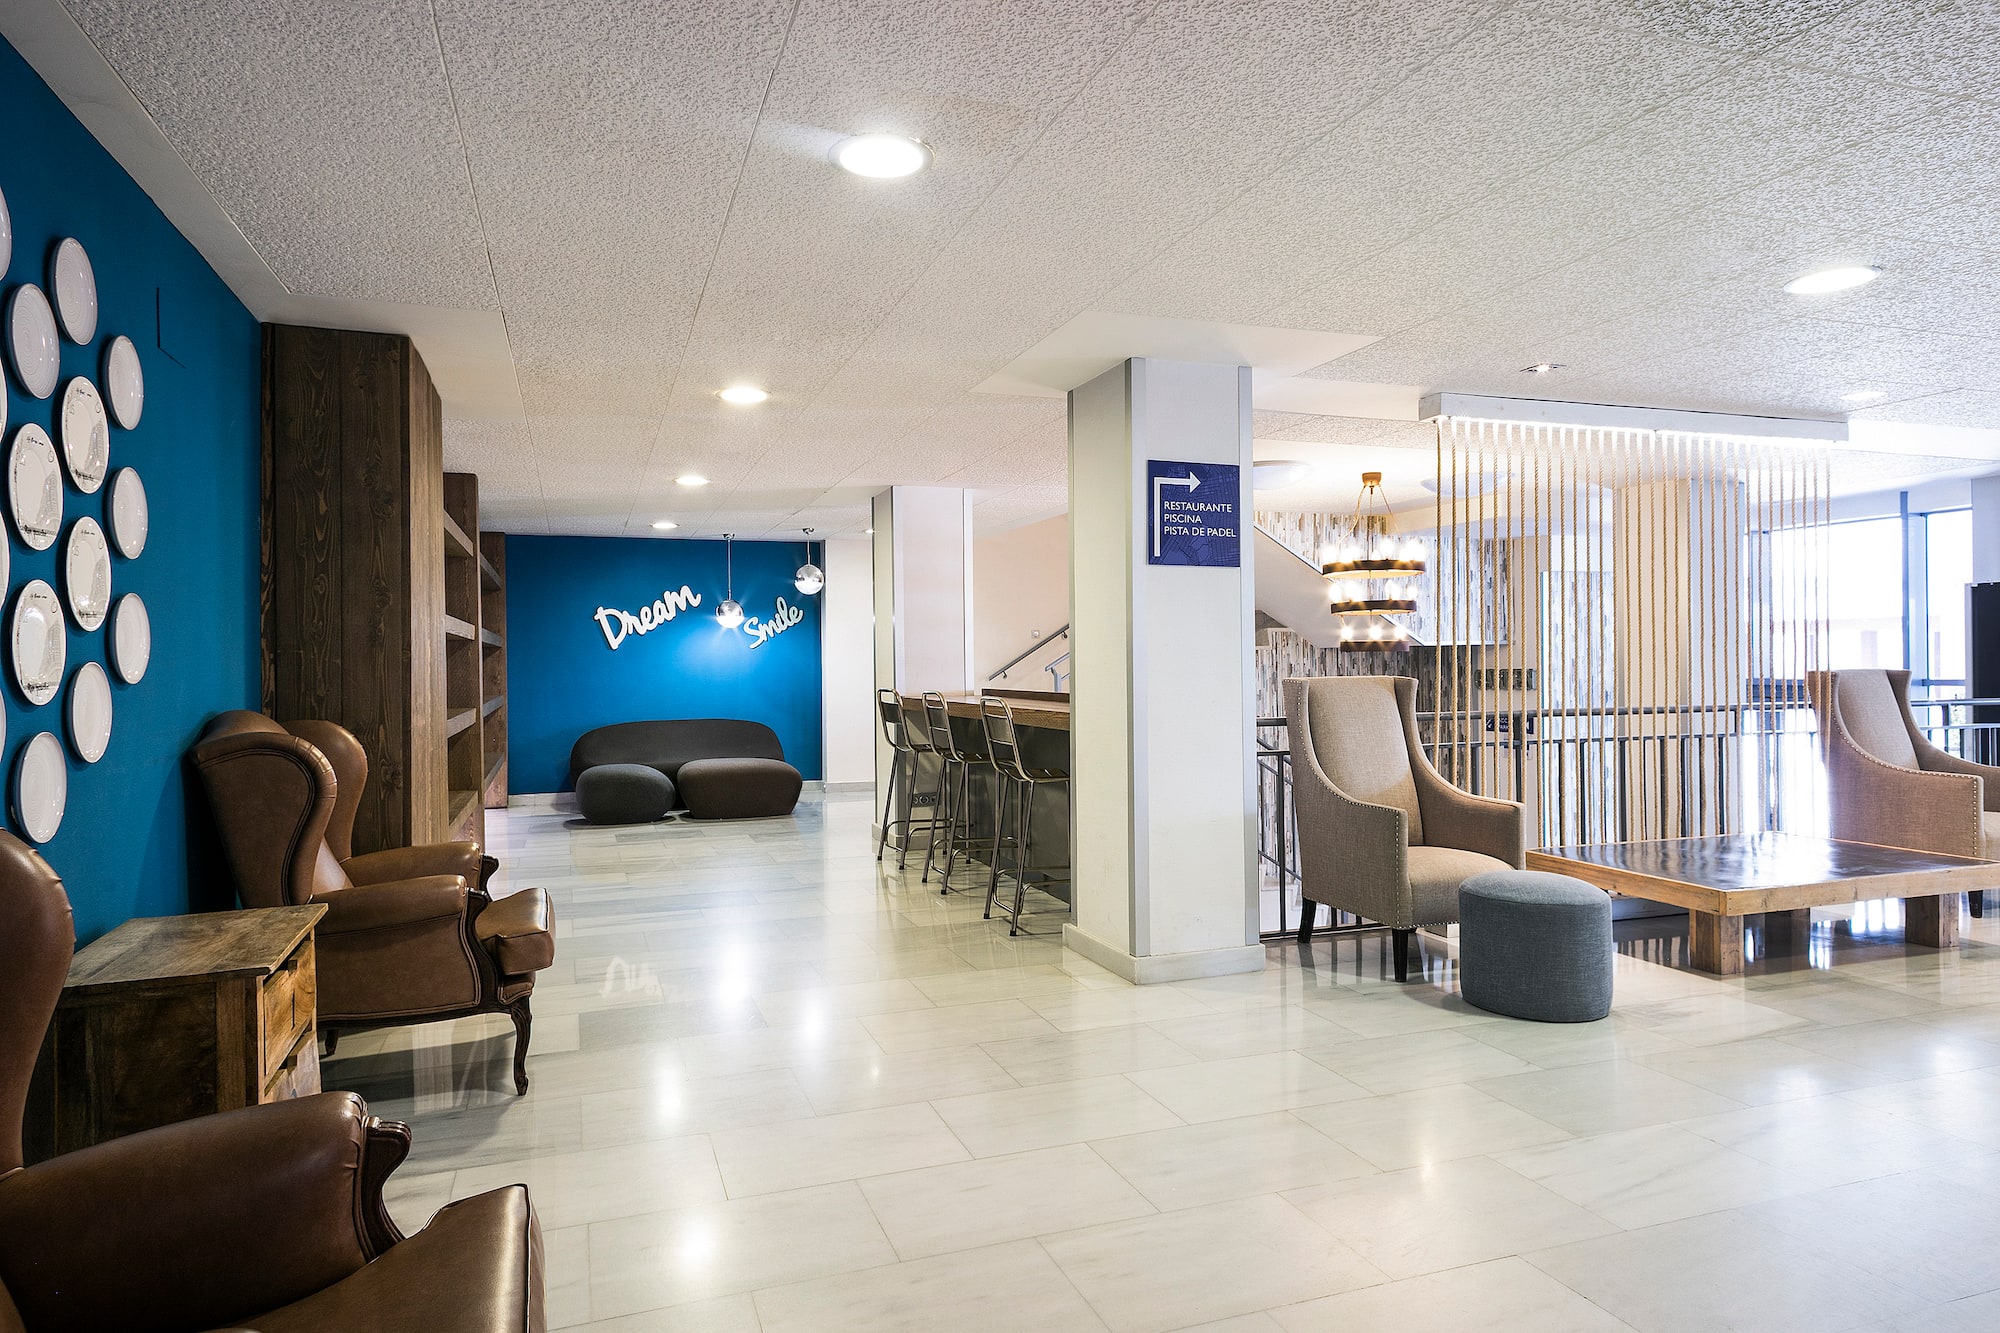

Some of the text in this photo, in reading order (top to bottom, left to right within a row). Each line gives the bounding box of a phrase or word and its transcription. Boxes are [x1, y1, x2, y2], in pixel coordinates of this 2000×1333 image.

[1164, 501, 1232, 513] RESTAURANTE
[1164, 514, 1202, 524] PISCINA
[1164, 526, 1237, 538] PISTA DE PADEL
[594, 585, 702, 650] Dream
[743, 597, 804, 649] Smile
